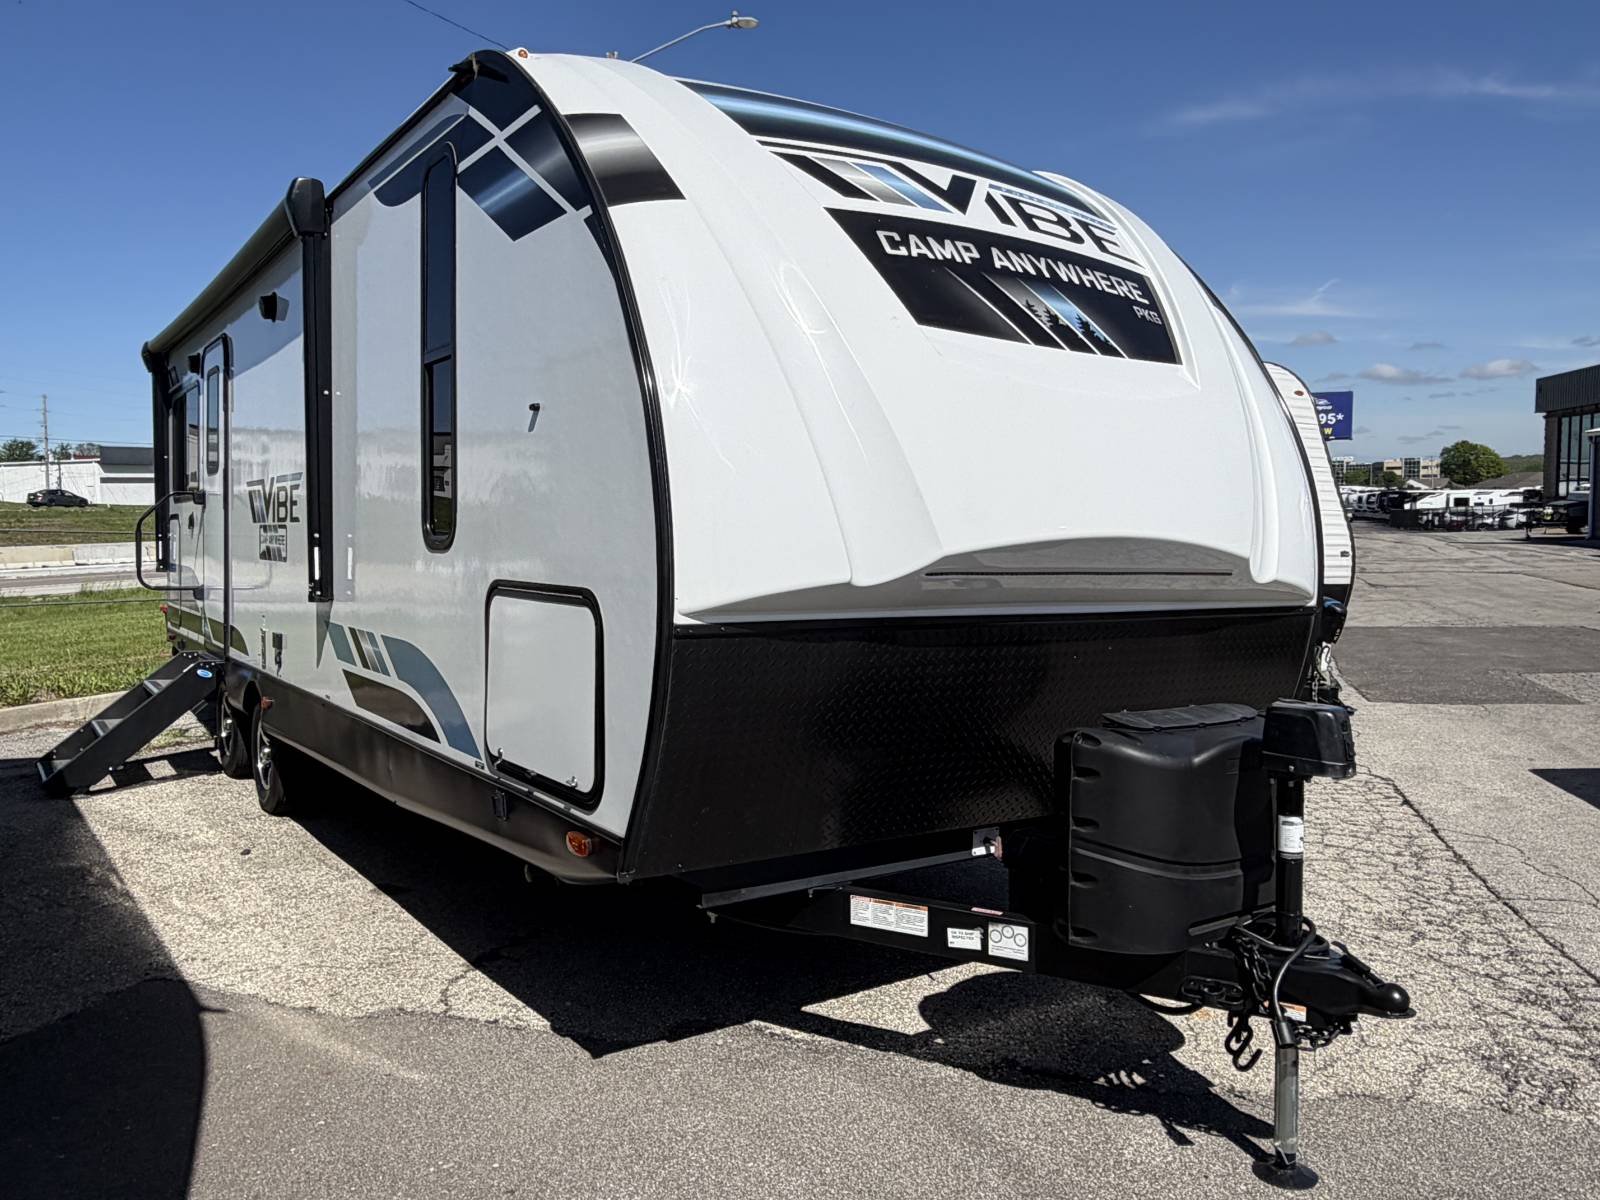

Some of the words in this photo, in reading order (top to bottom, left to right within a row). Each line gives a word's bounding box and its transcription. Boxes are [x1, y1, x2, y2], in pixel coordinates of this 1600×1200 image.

[756, 140, 1146, 269] VIBE
[876, 230, 981, 264] CAMP
[990, 246, 1151, 304] ANYWHERE
[1132, 305, 1161, 325] PKG
[246, 474, 300, 523] VIBE
